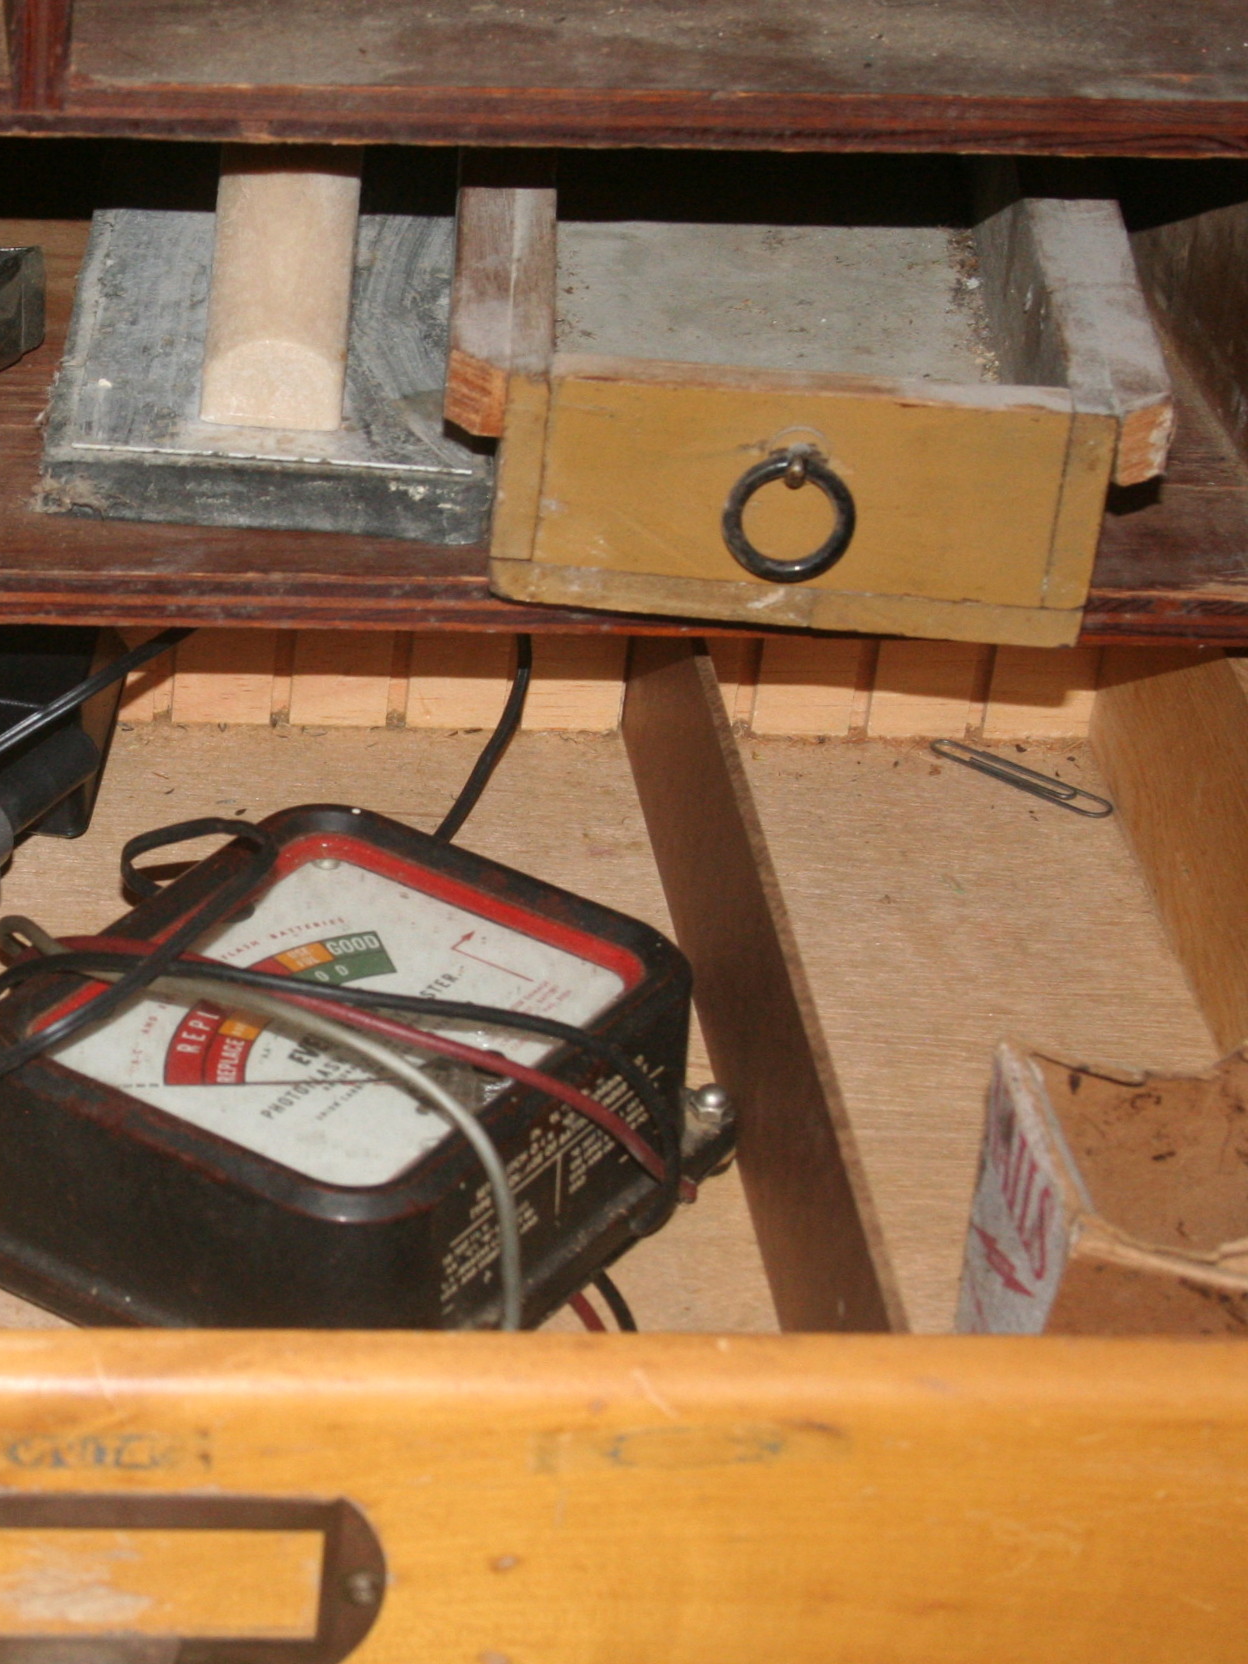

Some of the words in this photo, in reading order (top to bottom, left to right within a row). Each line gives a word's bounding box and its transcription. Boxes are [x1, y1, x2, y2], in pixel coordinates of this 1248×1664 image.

[325, 934, 379, 957] GOOD
[419, 973, 459, 1000] STER
[176, 1009, 221, 1054] REPL
[216, 1037, 246, 1084] REPLACE
